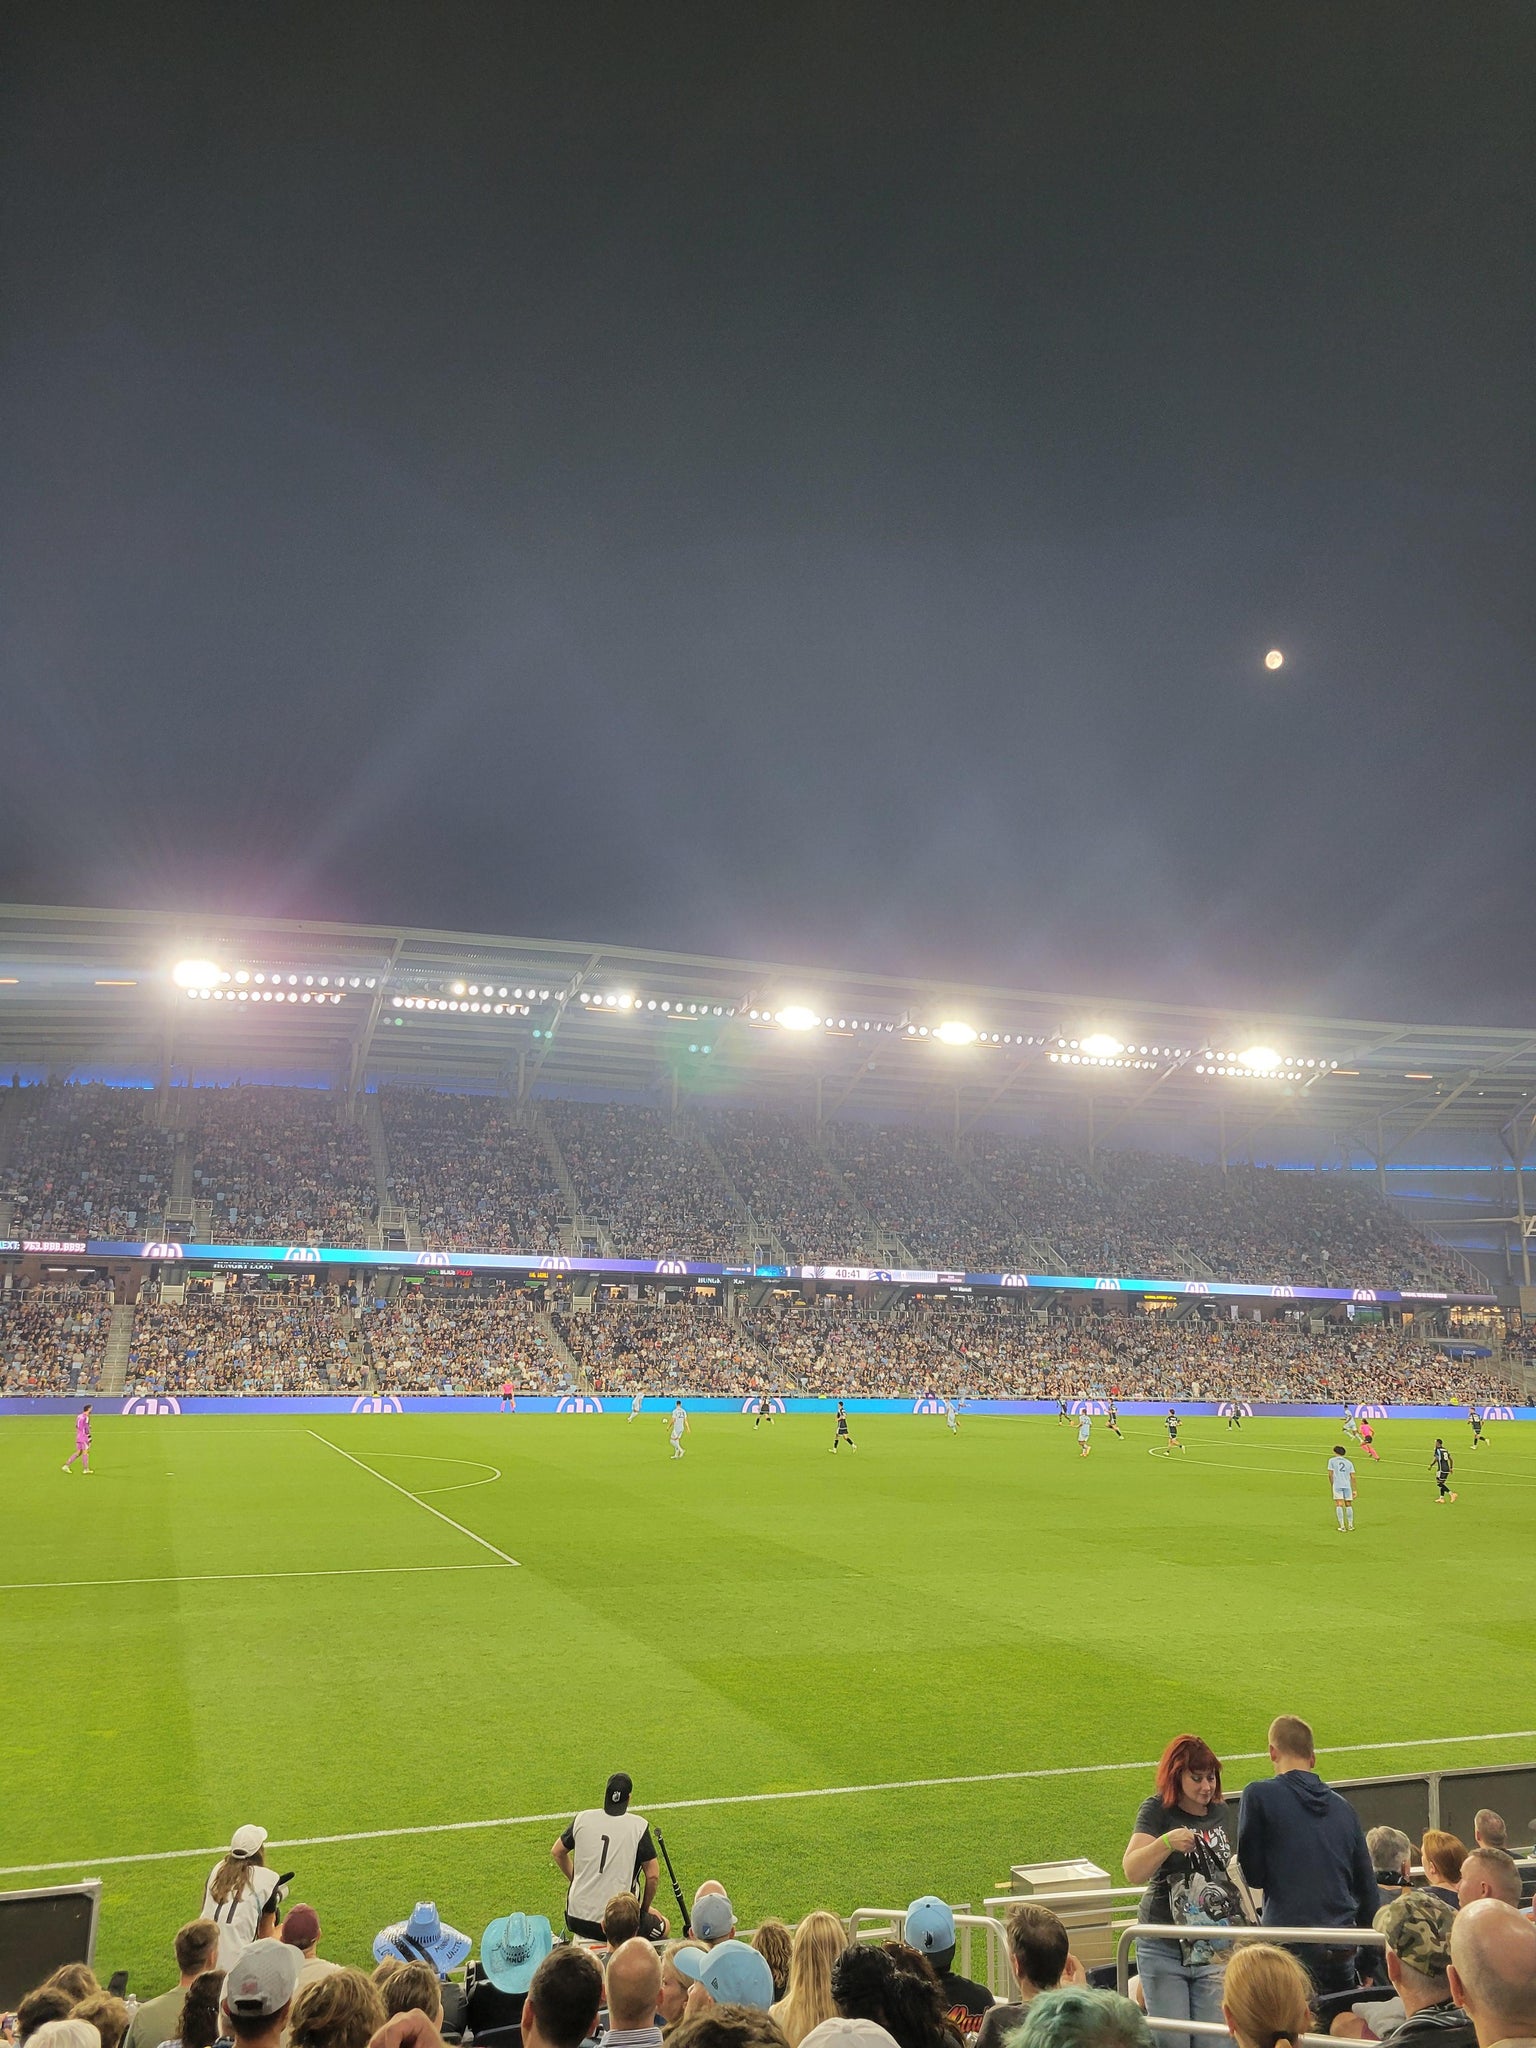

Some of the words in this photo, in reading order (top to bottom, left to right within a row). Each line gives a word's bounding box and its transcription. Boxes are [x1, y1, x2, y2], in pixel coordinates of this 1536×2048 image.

[835, 1268, 861, 1279] 40:41
[1443, 1451, 1449, 1461] 8
[1338, 1462, 1346, 1473] 2
[600, 1834, 610, 1874] 1
[505, 1951, 531, 1964] MNUFC
